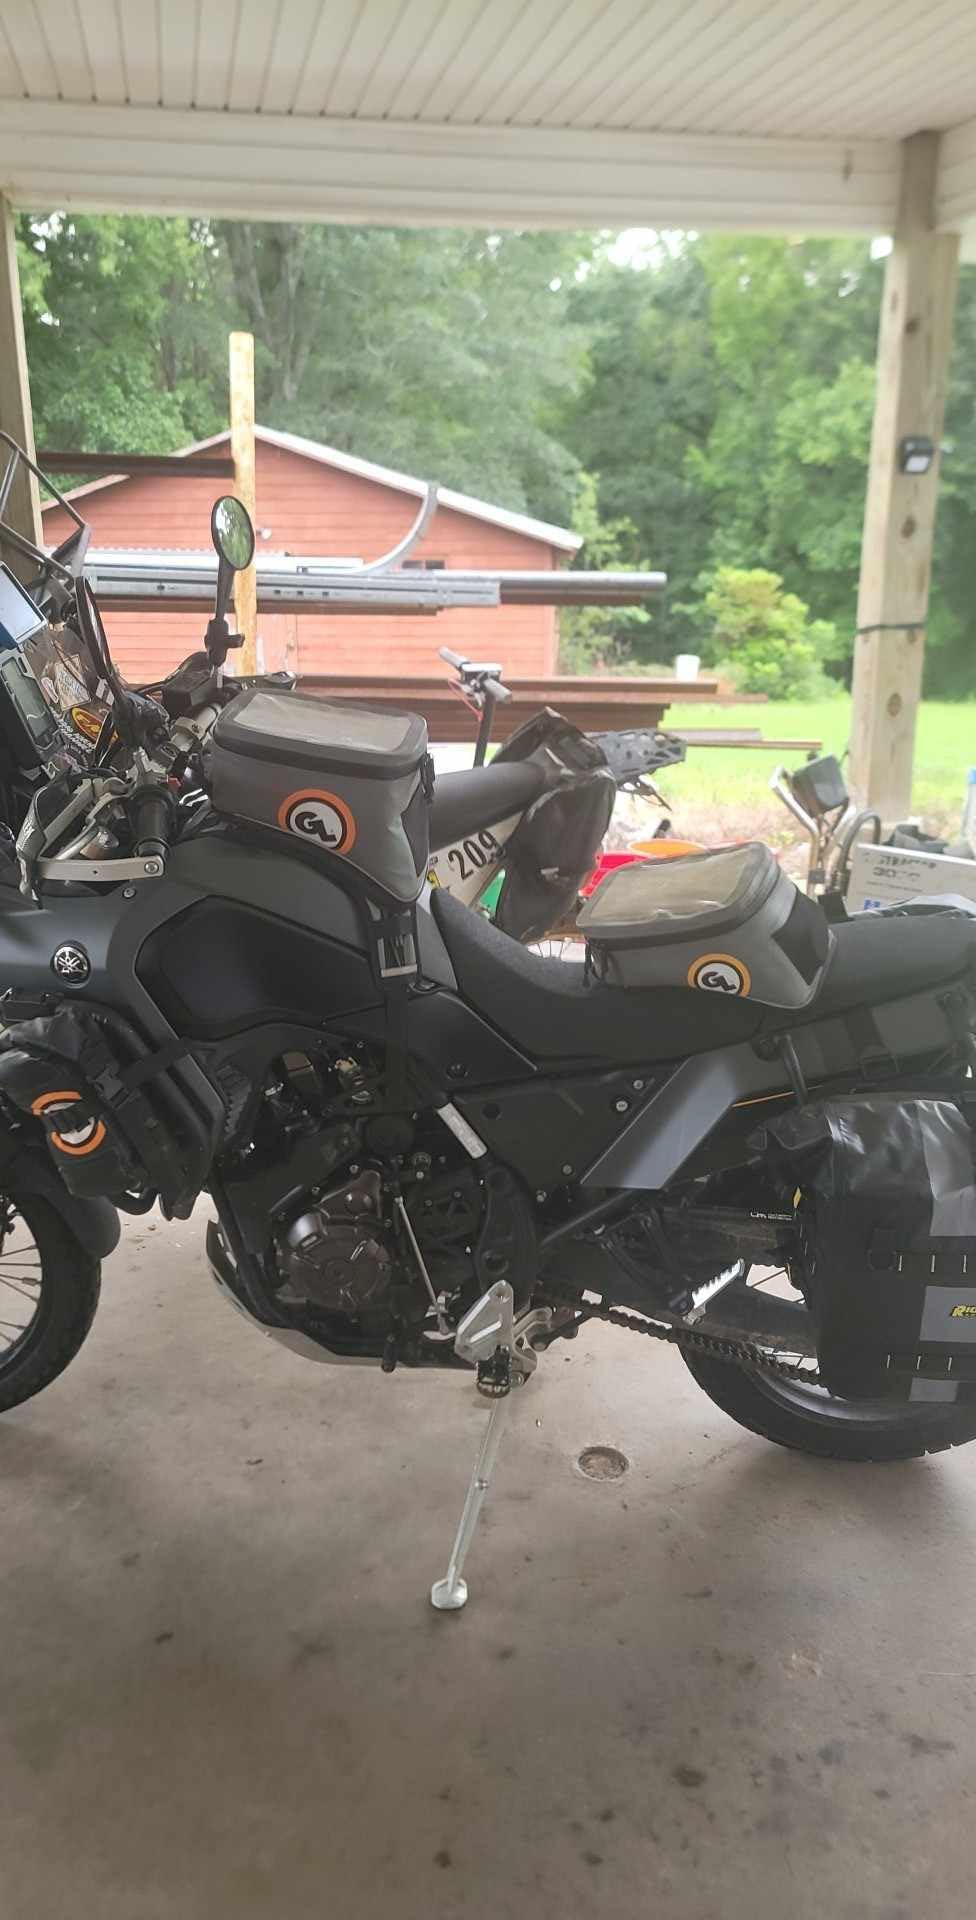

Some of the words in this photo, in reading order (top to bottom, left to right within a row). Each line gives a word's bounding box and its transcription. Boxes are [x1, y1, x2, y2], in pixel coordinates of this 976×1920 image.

[294, 811, 338, 842] GL
[447, 830, 498, 881] 209
[701, 971, 737, 992] GL
